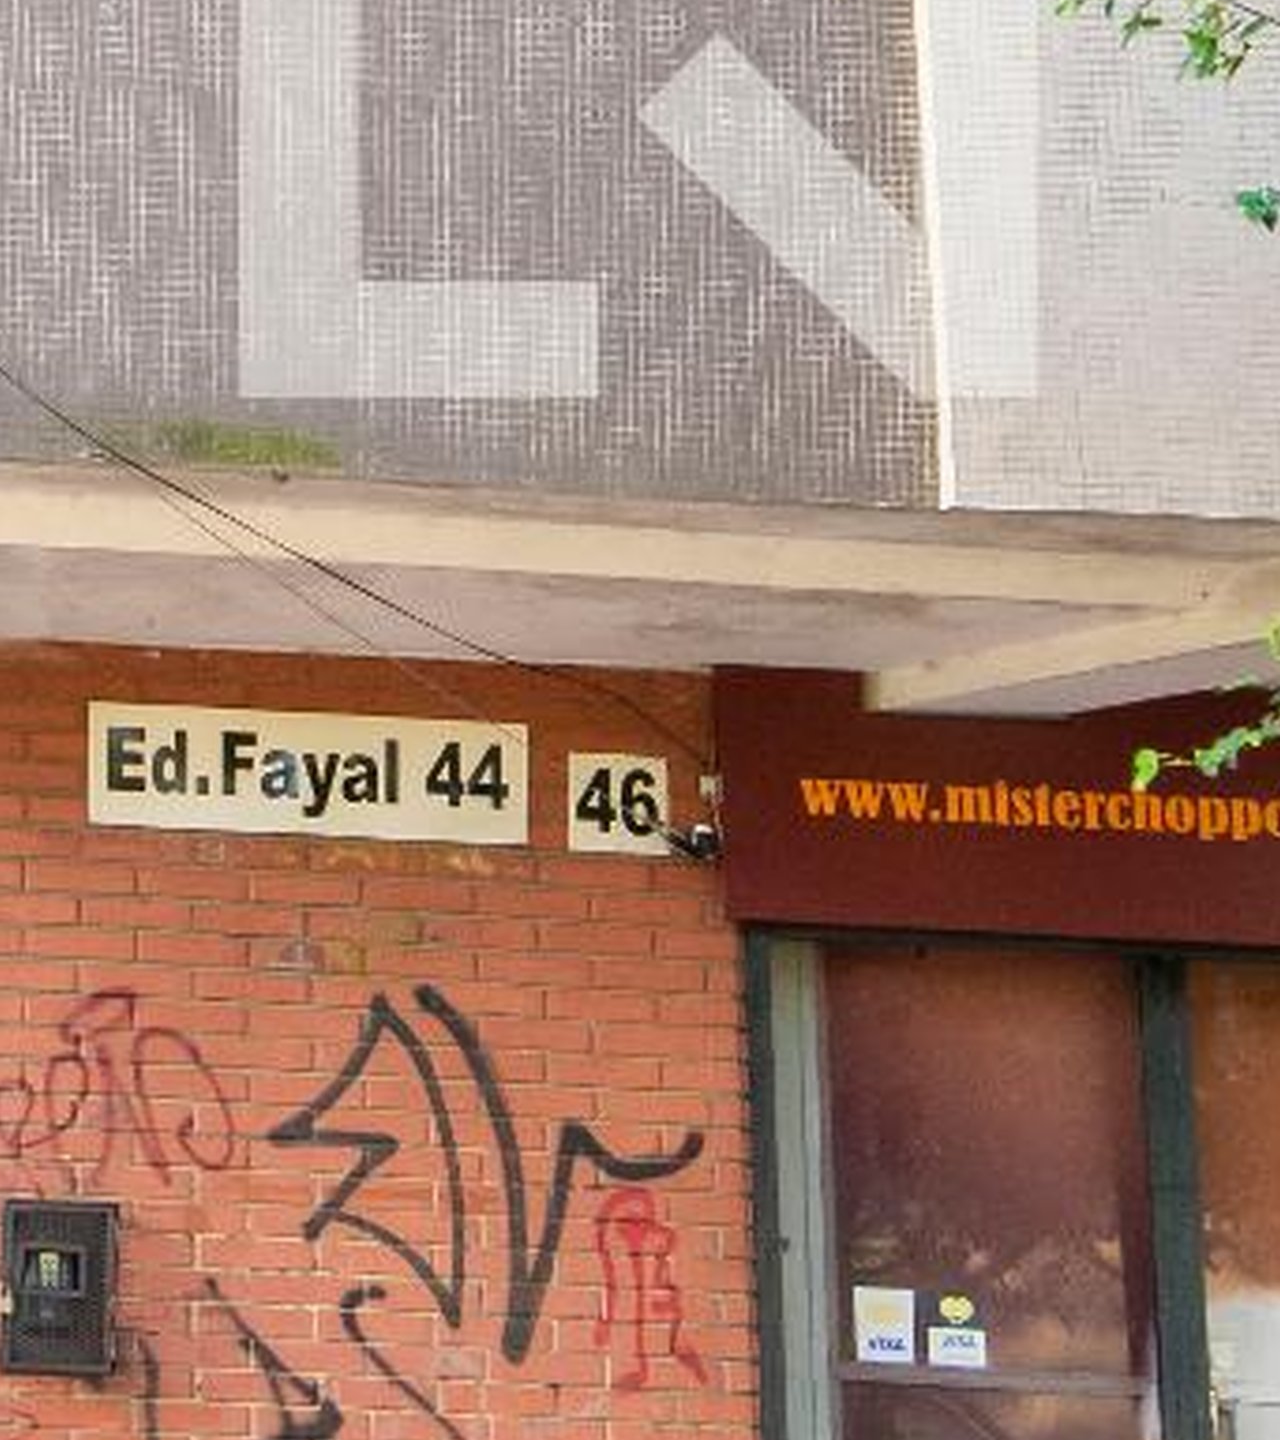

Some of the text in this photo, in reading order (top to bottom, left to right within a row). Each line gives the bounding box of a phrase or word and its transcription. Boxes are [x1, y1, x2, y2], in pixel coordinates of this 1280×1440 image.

[106, 726, 509, 817] Ed.Fayal 44
[575, 767, 660, 834] 46
